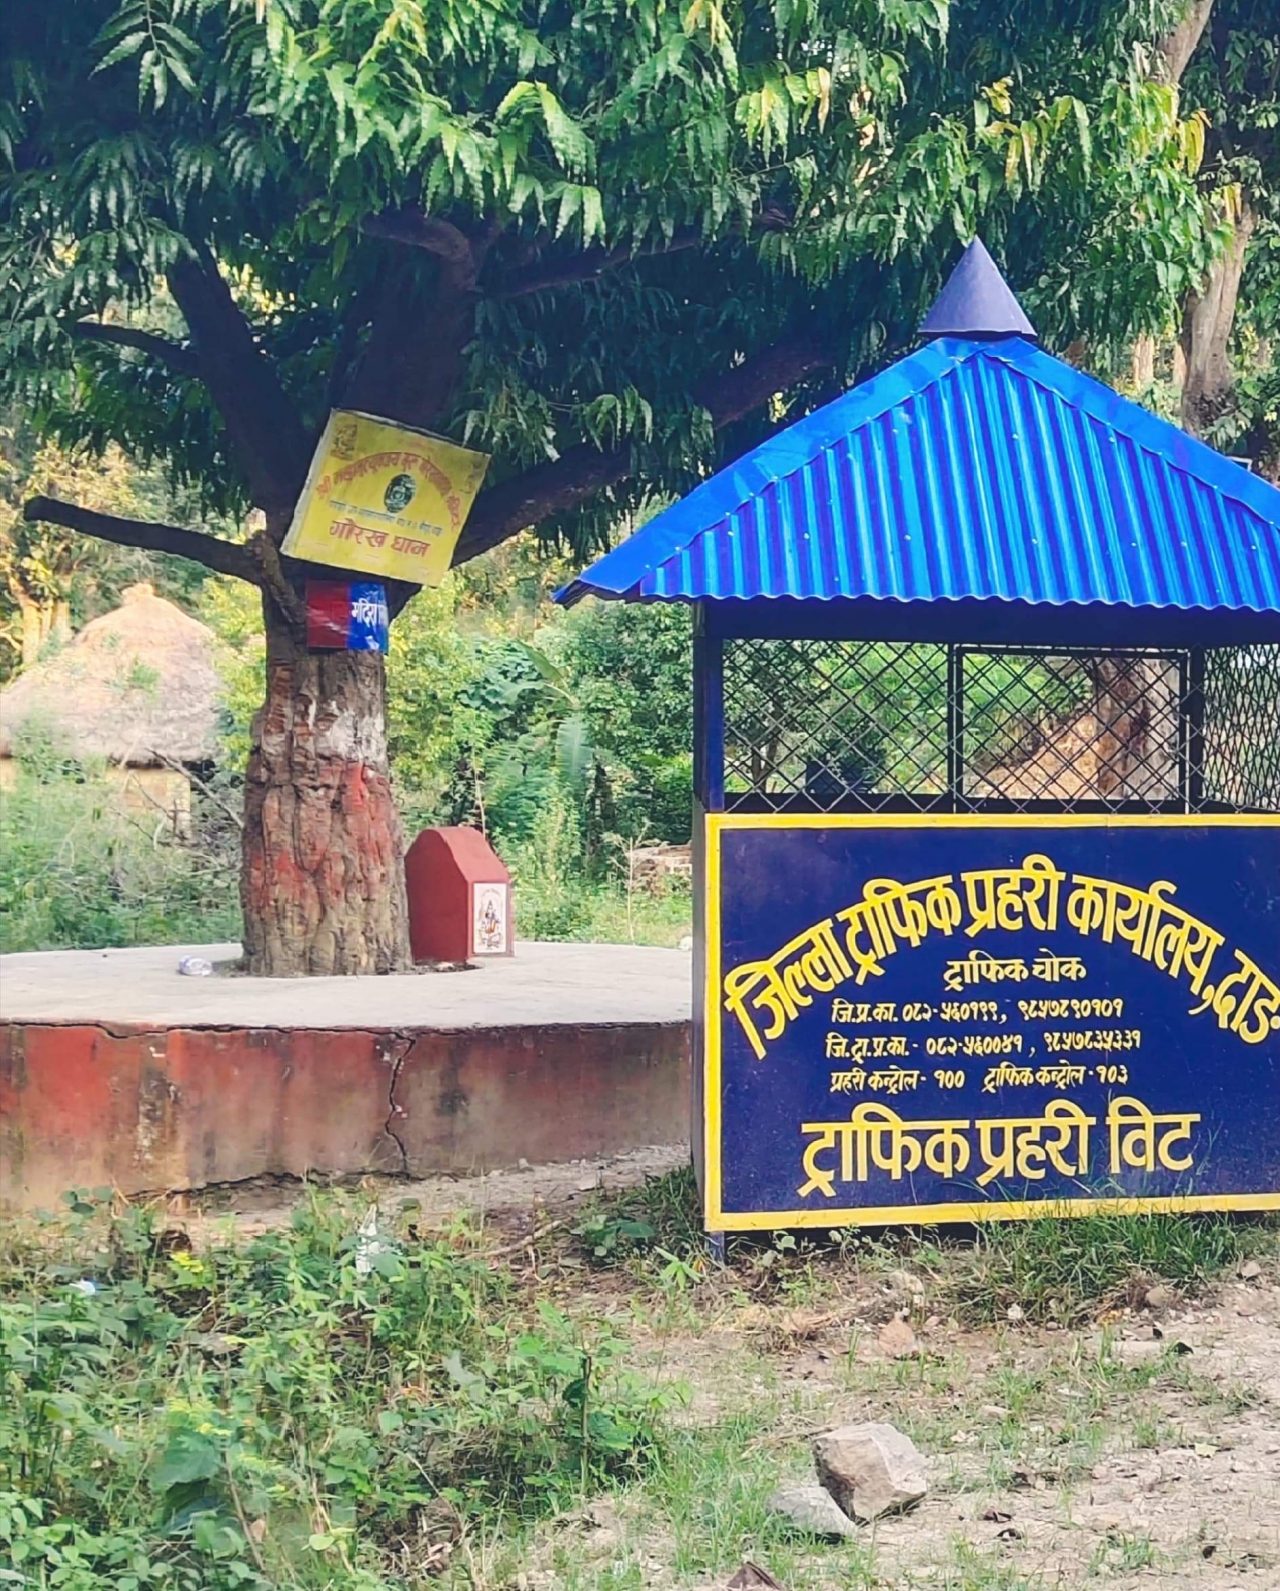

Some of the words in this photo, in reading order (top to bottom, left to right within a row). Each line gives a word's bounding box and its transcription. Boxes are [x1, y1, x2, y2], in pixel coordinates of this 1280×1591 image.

[724, 919, 853, 1059] जिल्ला
[836, 874, 961, 986] ट्राफिक
[961, 853, 1066, 936] प्रहरी
[943, 950, 1029, 991] ट्राफिक
[1032, 948, 1087, 982] चोक
[1018, 998, 1124, 1021] ९८५७८९०१०१
[1043, 1030, 1141, 1052] ९८५७८३५३३१
[830, 1067, 867, 1096] प्रहरी
[934, 1070, 965, 1089] १००
[981, 1061, 1034, 1093] ट्राफिक
[797, 1102, 970, 1198] ट्राफिक
[974, 1098, 1097, 1187] प्रहरी
